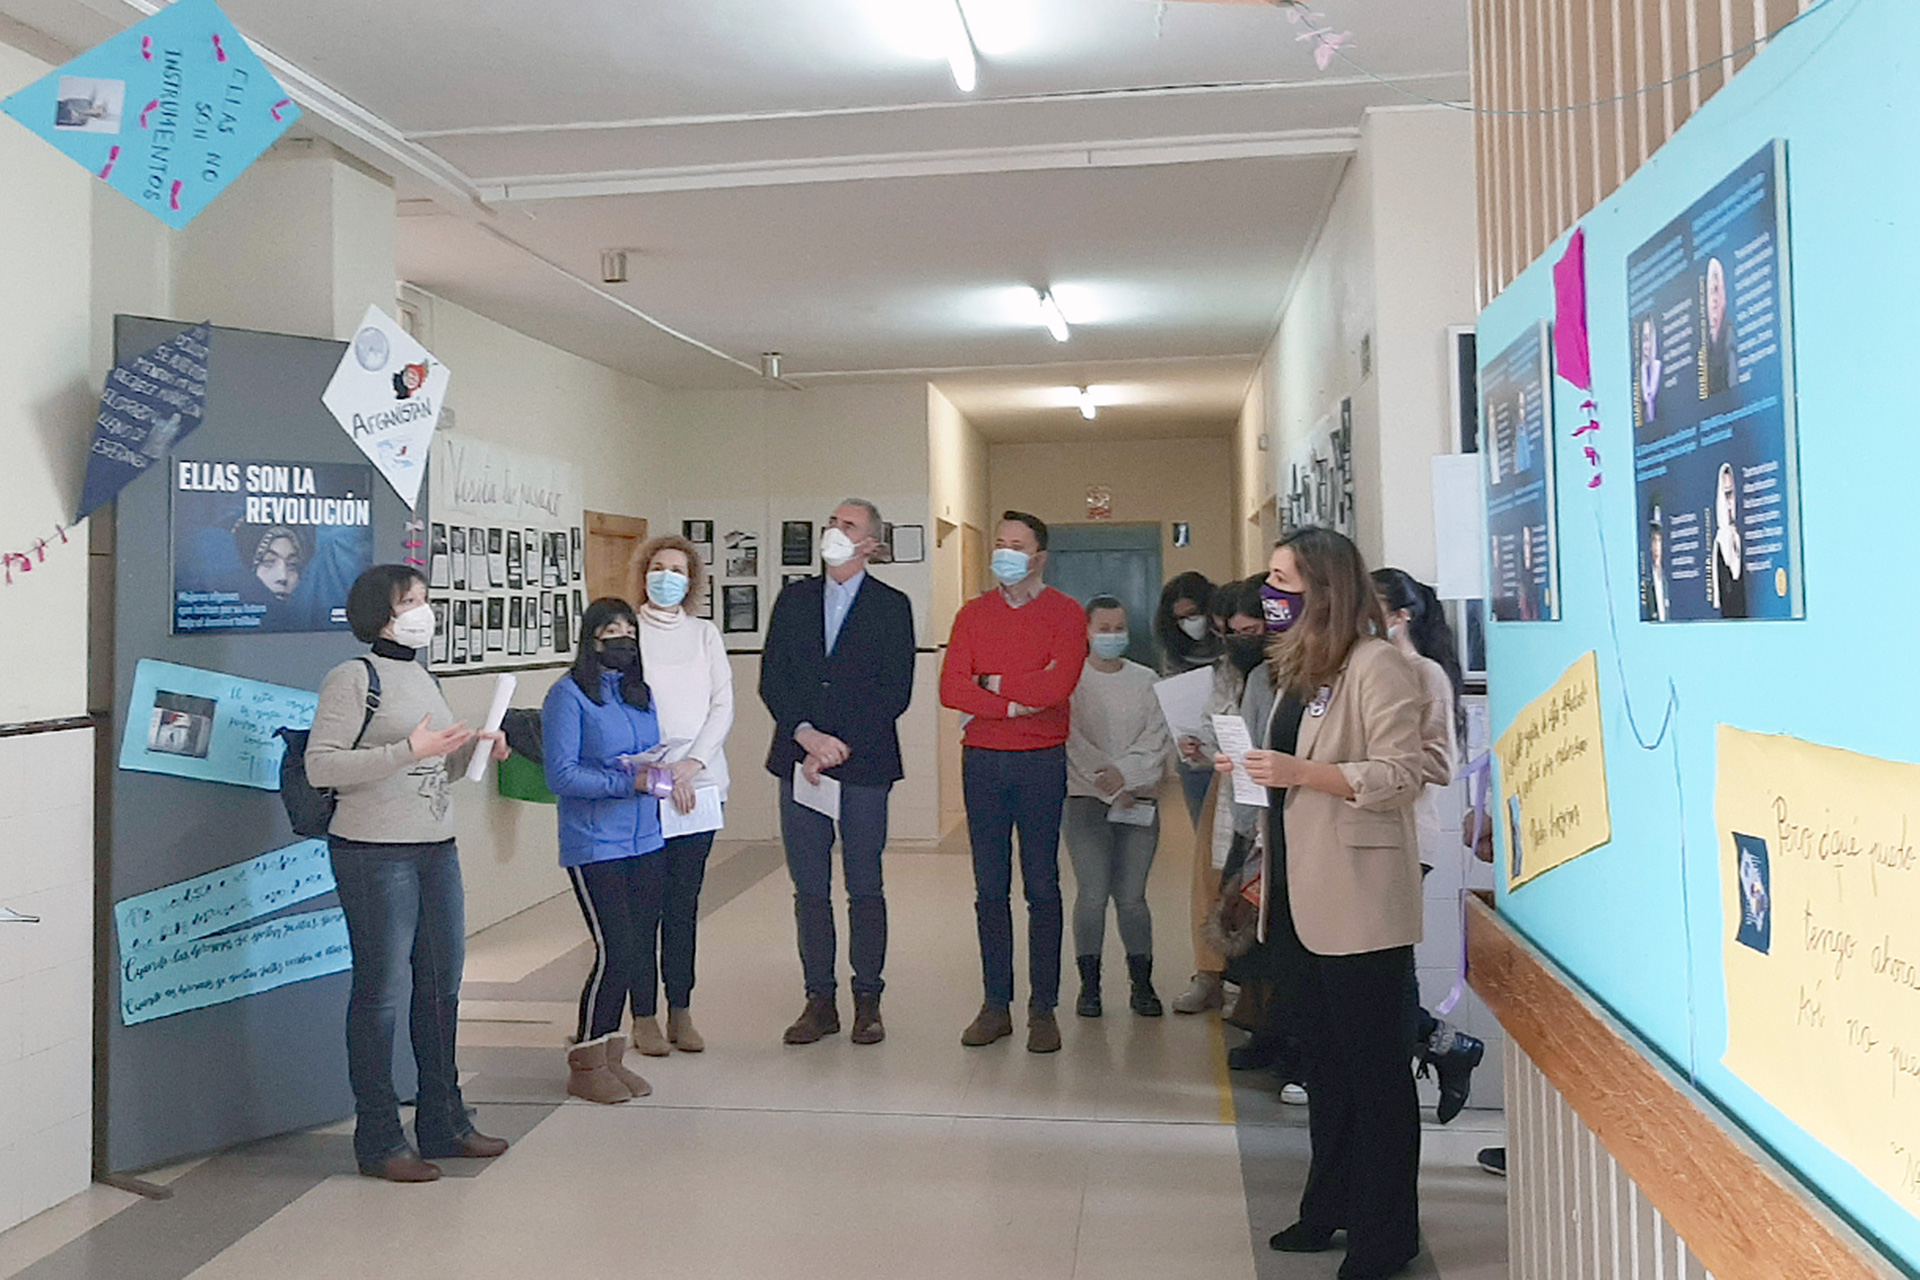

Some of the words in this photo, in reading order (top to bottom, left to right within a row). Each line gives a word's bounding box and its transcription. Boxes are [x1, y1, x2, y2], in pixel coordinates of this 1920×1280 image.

[143, 49, 182, 200] INSTRUMENTOS
[216, 67, 249, 135] ELLAS
[202, 152, 221, 183] NO
[179, 461, 240, 492] ELLAS
[246, 464, 288, 493] SON
[292, 467, 316, 494] LA
[246, 492, 370, 526] REVOLUCIÓN
[1772, 795, 1814, 860] Pero
[1803, 900, 1858, 981] tengo
[1847, 1019, 1879, 1053] no
